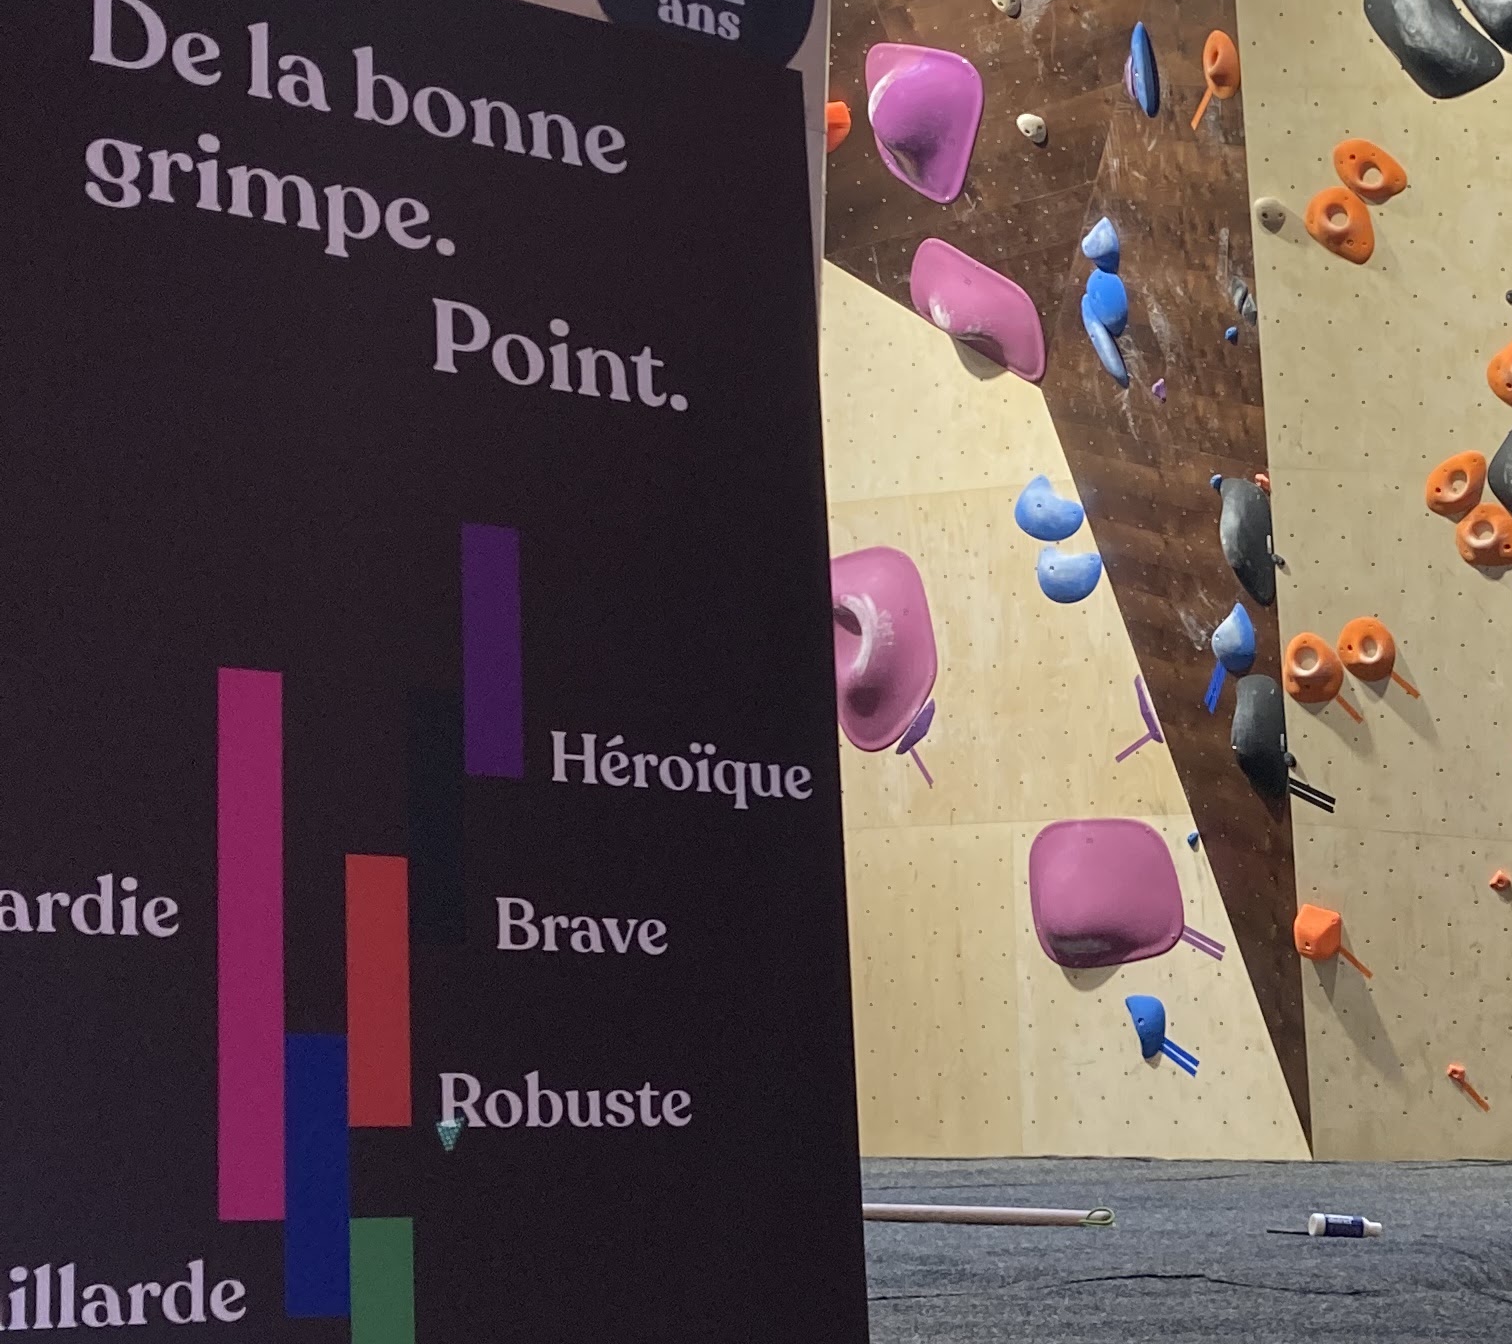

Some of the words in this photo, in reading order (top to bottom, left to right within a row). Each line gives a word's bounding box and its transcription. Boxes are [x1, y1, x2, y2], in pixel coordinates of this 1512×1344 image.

[247, 21, 332, 112] la
[352, 45, 628, 174] bonne
[85, 133, 456, 258] grimpe.
[432, 297, 688, 412] Point.
[550, 730, 813, 810] Héroïque
[495, 896, 668, 956] Brave
[437, 1070, 693, 1129] Robuste
[0, 1258, 247, 1332] illarde
